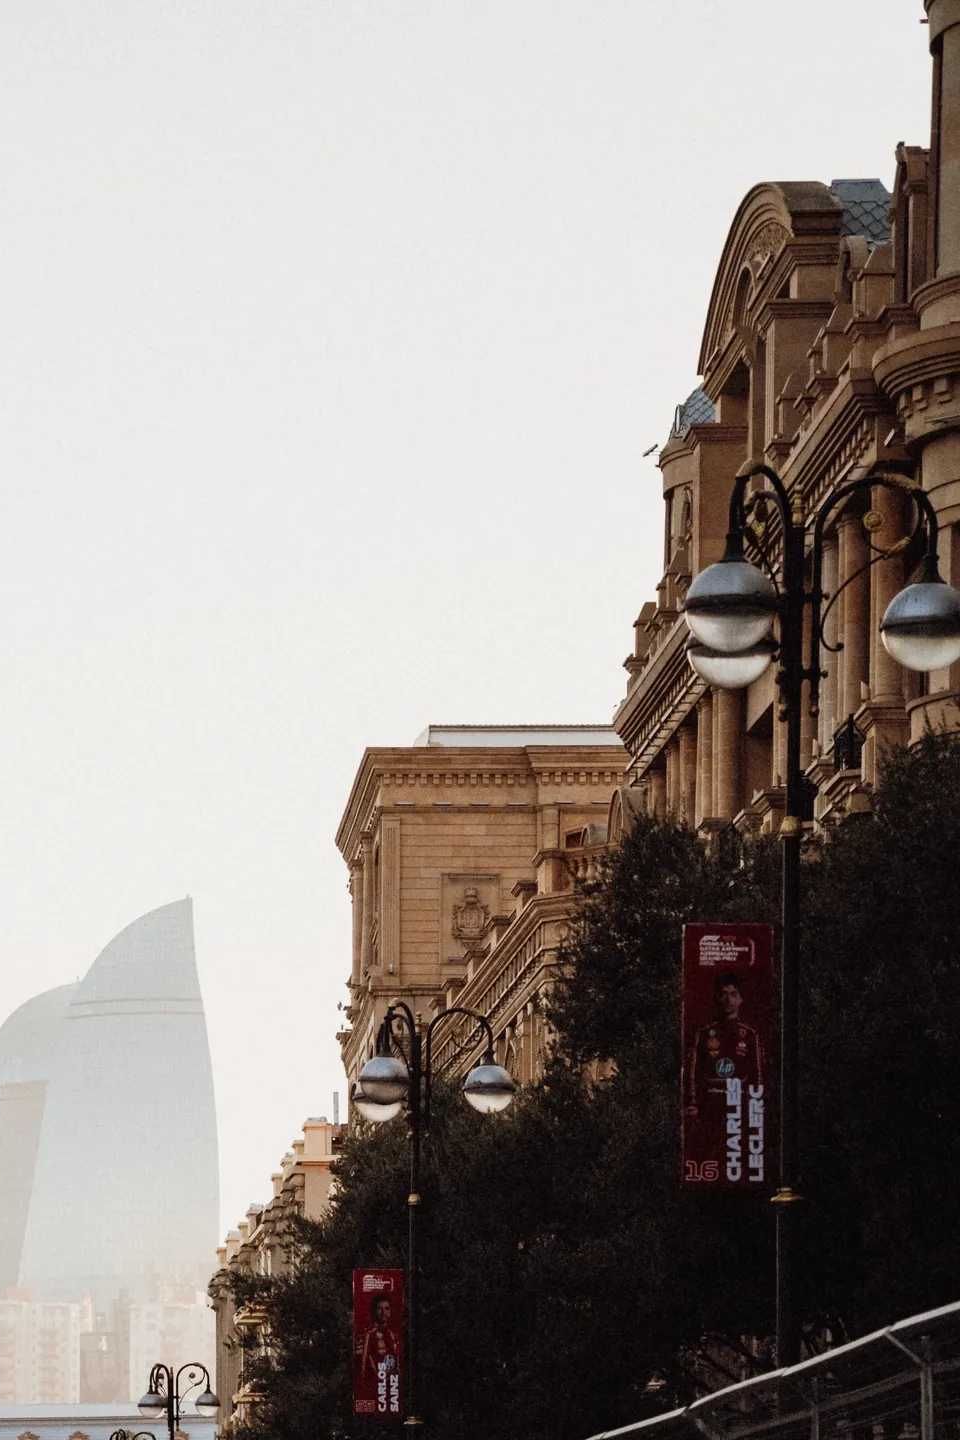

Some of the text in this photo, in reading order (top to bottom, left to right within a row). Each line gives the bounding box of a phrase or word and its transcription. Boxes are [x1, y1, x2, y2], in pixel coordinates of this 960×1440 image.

[726, 1078, 742, 1182] CHARLES
[748, 1084, 764, 1182] LECLERC
[685, 1160, 719, 1181] 16
[356, 1399, 376, 1412] 55
[377, 1362, 387, 1412] CARLOS
[390, 1374, 399, 1412] SAINZ
